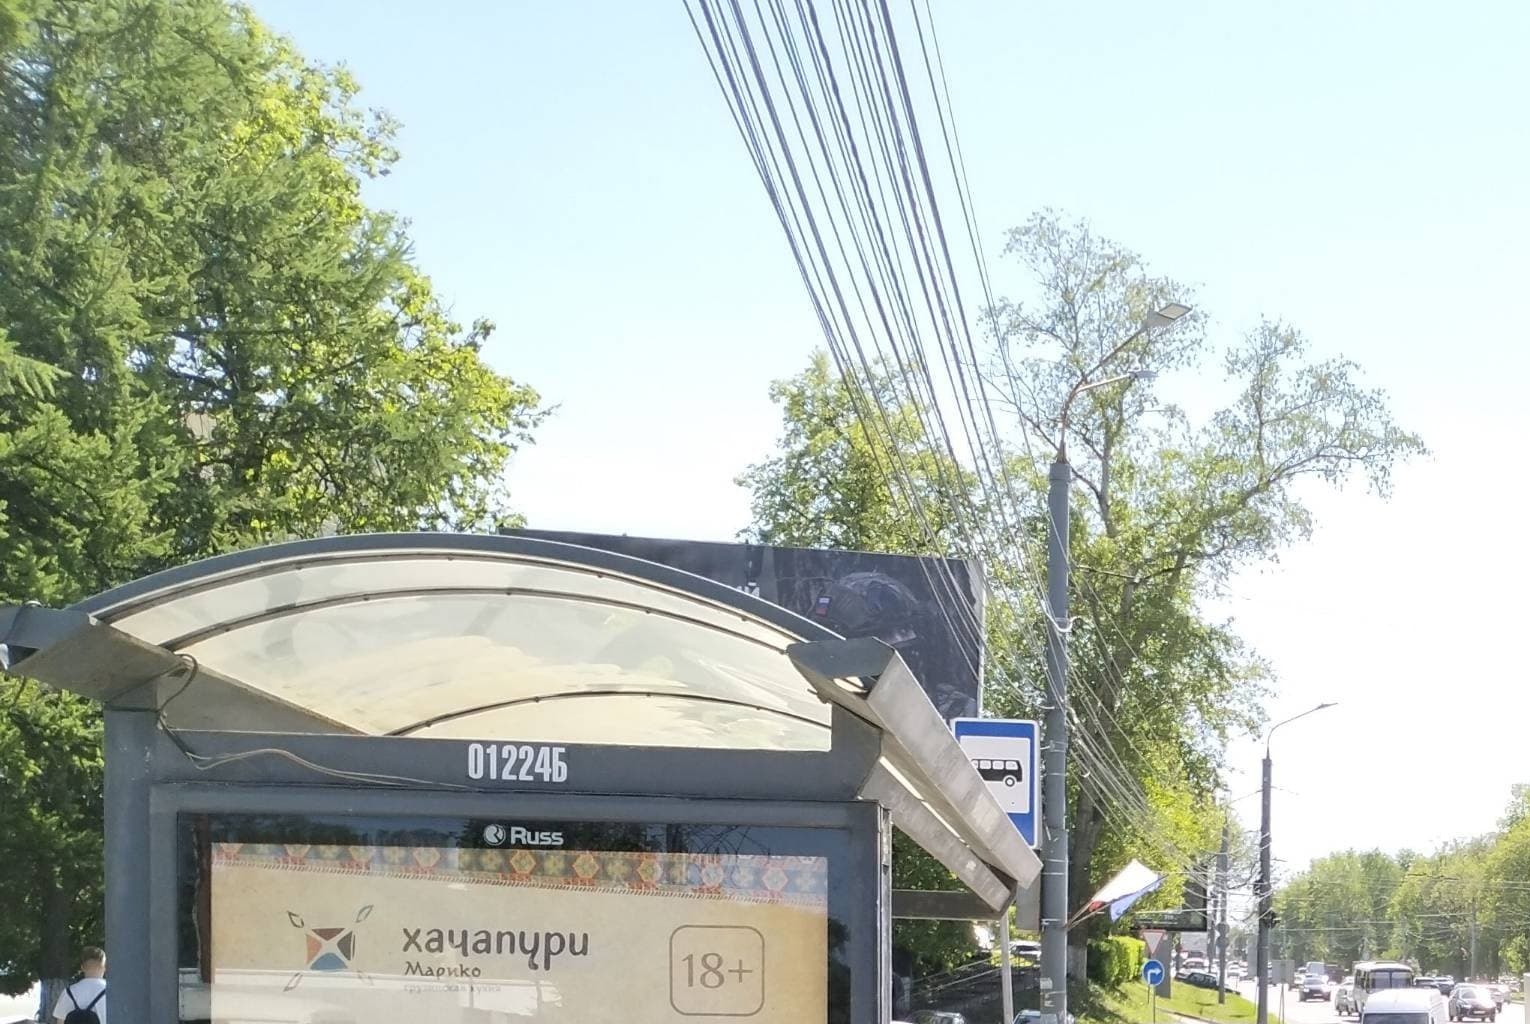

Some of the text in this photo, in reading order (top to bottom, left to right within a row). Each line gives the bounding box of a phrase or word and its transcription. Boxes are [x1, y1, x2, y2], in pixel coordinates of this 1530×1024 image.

[510, 826, 564, 846] Russ
[402, 927, 589, 972] хачапури
[404, 961, 482, 980] Марико
[681, 951, 754, 990] 18+
